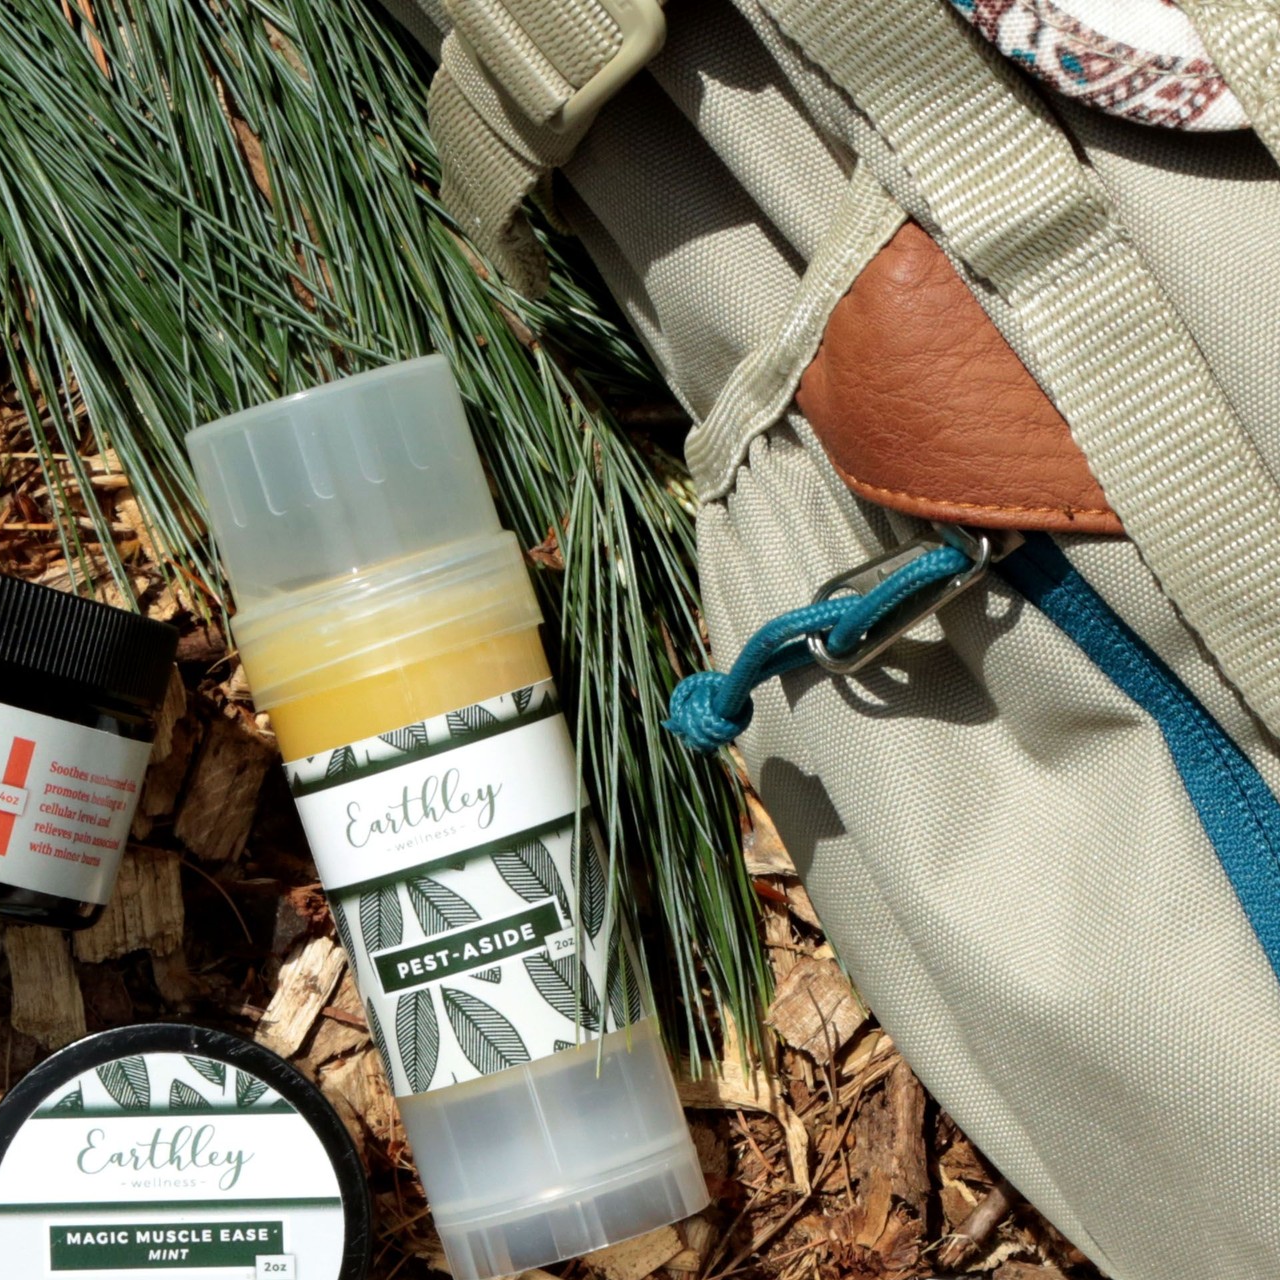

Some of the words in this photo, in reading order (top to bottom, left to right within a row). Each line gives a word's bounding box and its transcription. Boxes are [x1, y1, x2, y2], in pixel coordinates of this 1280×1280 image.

[49, 761, 89, 781] Soothes
[44, 783, 90, 802] promotes
[39, 802, 77, 819] cellular
[345, 768, 503, 848] Earthley
[33, 821, 72, 840] relieves
[29, 841, 52, 855] with
[54, 847, 81, 861] minor
[397, 923, 536, 979] PEST-ASIDE
[76, 1124, 254, 1191] Earthley
[67, 1232, 129, 1245] MAGIC
[136, 1230, 212, 1244] MUSCLE
[220, 1229, 268, 1241] EASE
[148, 1249, 190, 1260] MINT
[264, 1262, 287, 1272] 2oz
